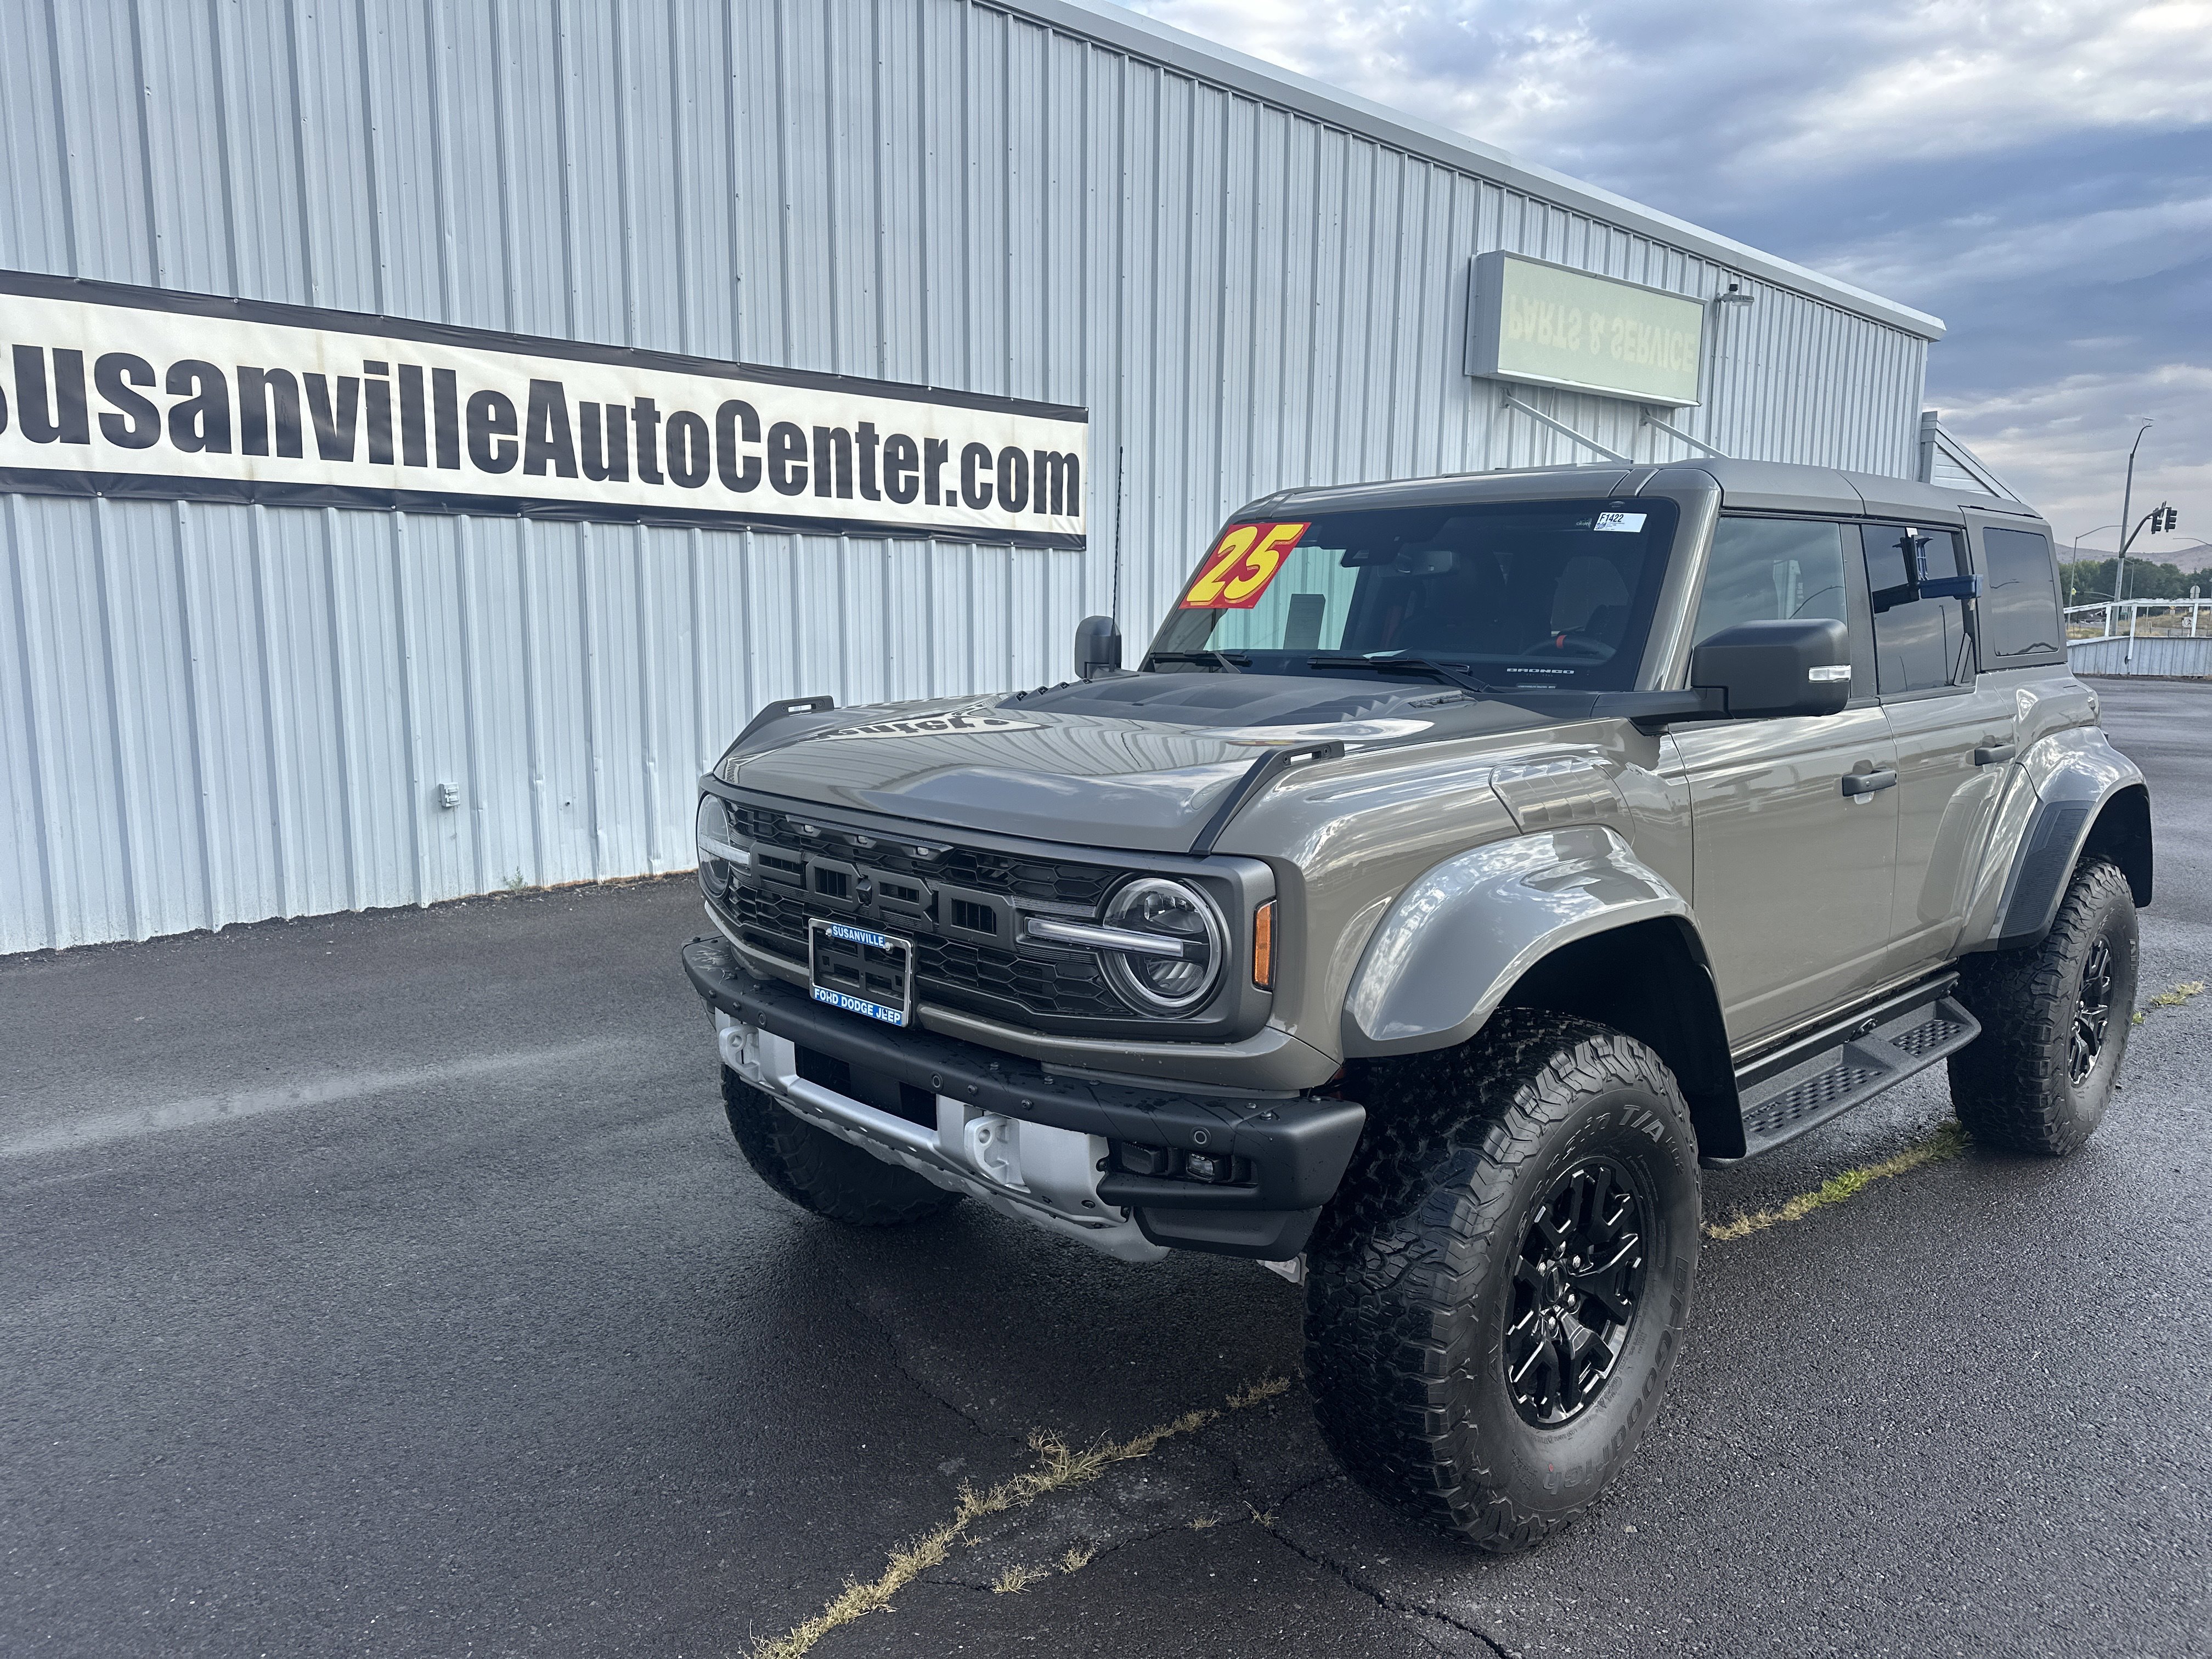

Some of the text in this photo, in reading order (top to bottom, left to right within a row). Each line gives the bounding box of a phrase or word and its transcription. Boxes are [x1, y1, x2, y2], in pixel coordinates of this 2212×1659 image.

[0, 343, 1079, 517] usanvilleAutoCenter.com
[1599, 514, 1624, 523] F1422
[1186, 523, 1305, 603] 25
[832, 926, 884, 947] SUSANVILLE
[814, 988, 901, 1024] FORD DODGE JEEP
[1618, 1104, 1666, 1143] T/A
